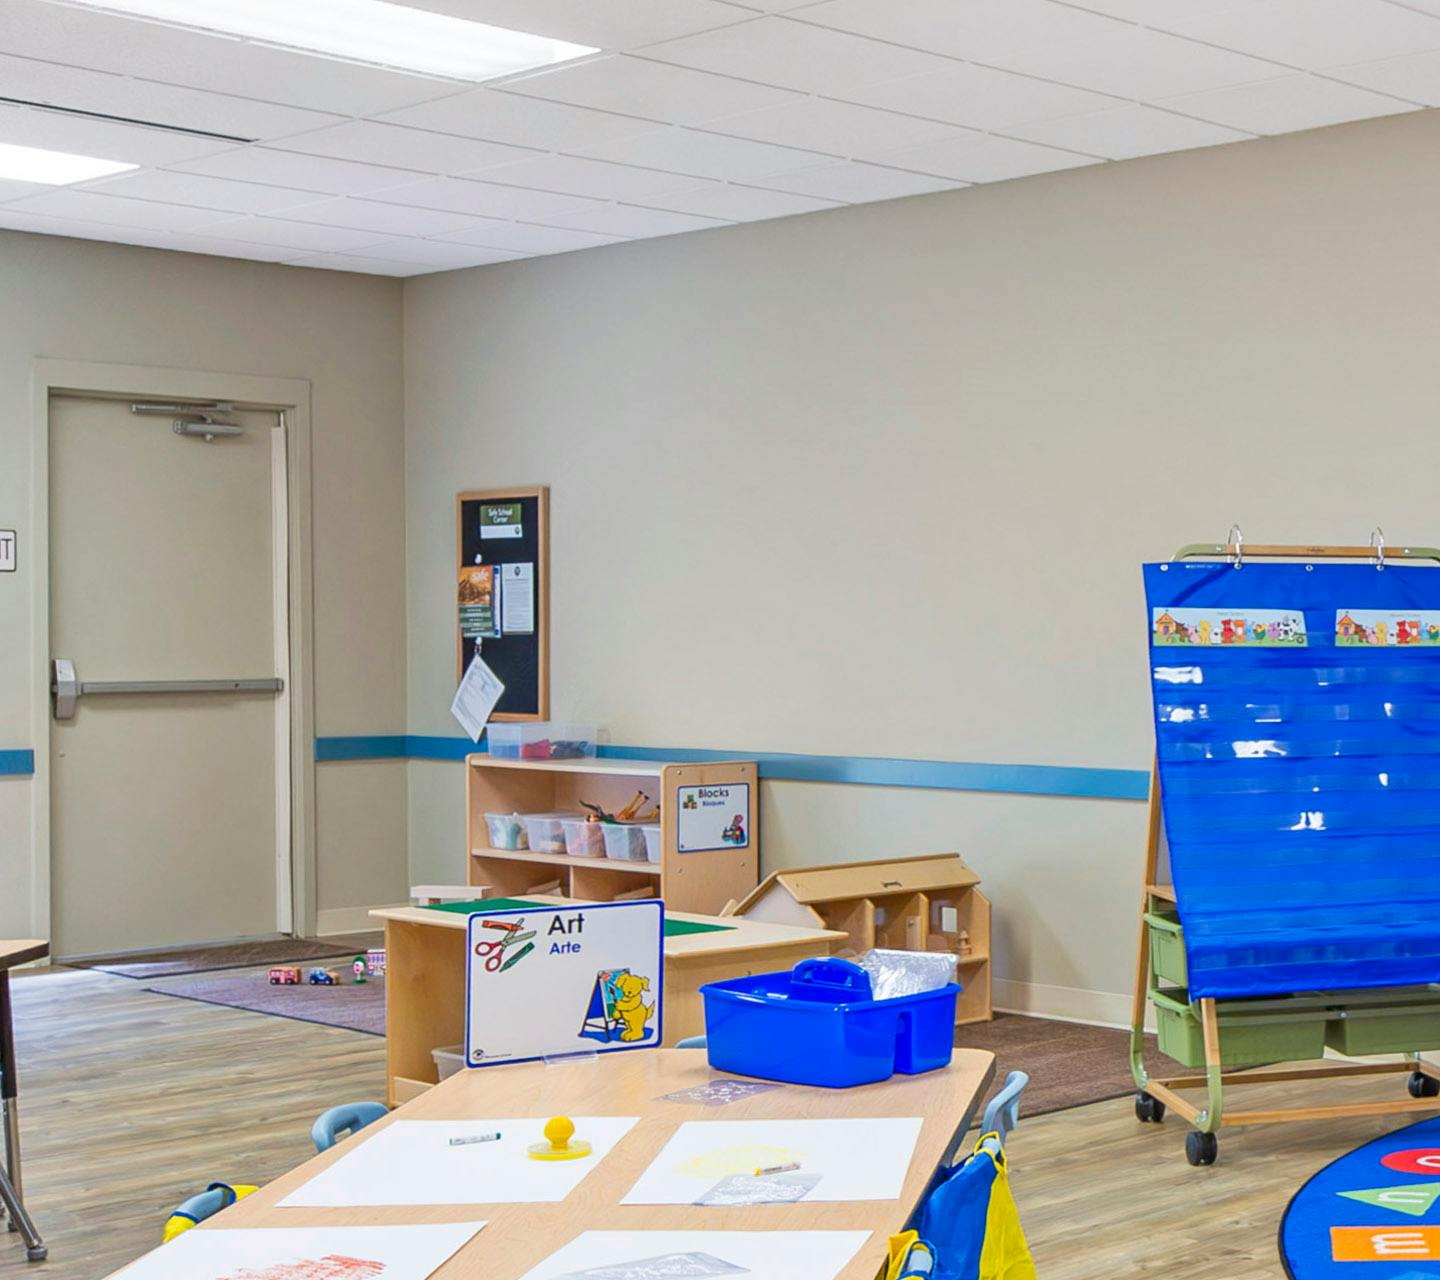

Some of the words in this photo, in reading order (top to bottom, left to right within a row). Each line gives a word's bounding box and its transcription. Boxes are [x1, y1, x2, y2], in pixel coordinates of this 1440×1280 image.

[698, 788, 729, 798] Blocks
[547, 913, 584, 936] Art
[549, 942, 581, 955] Arte
